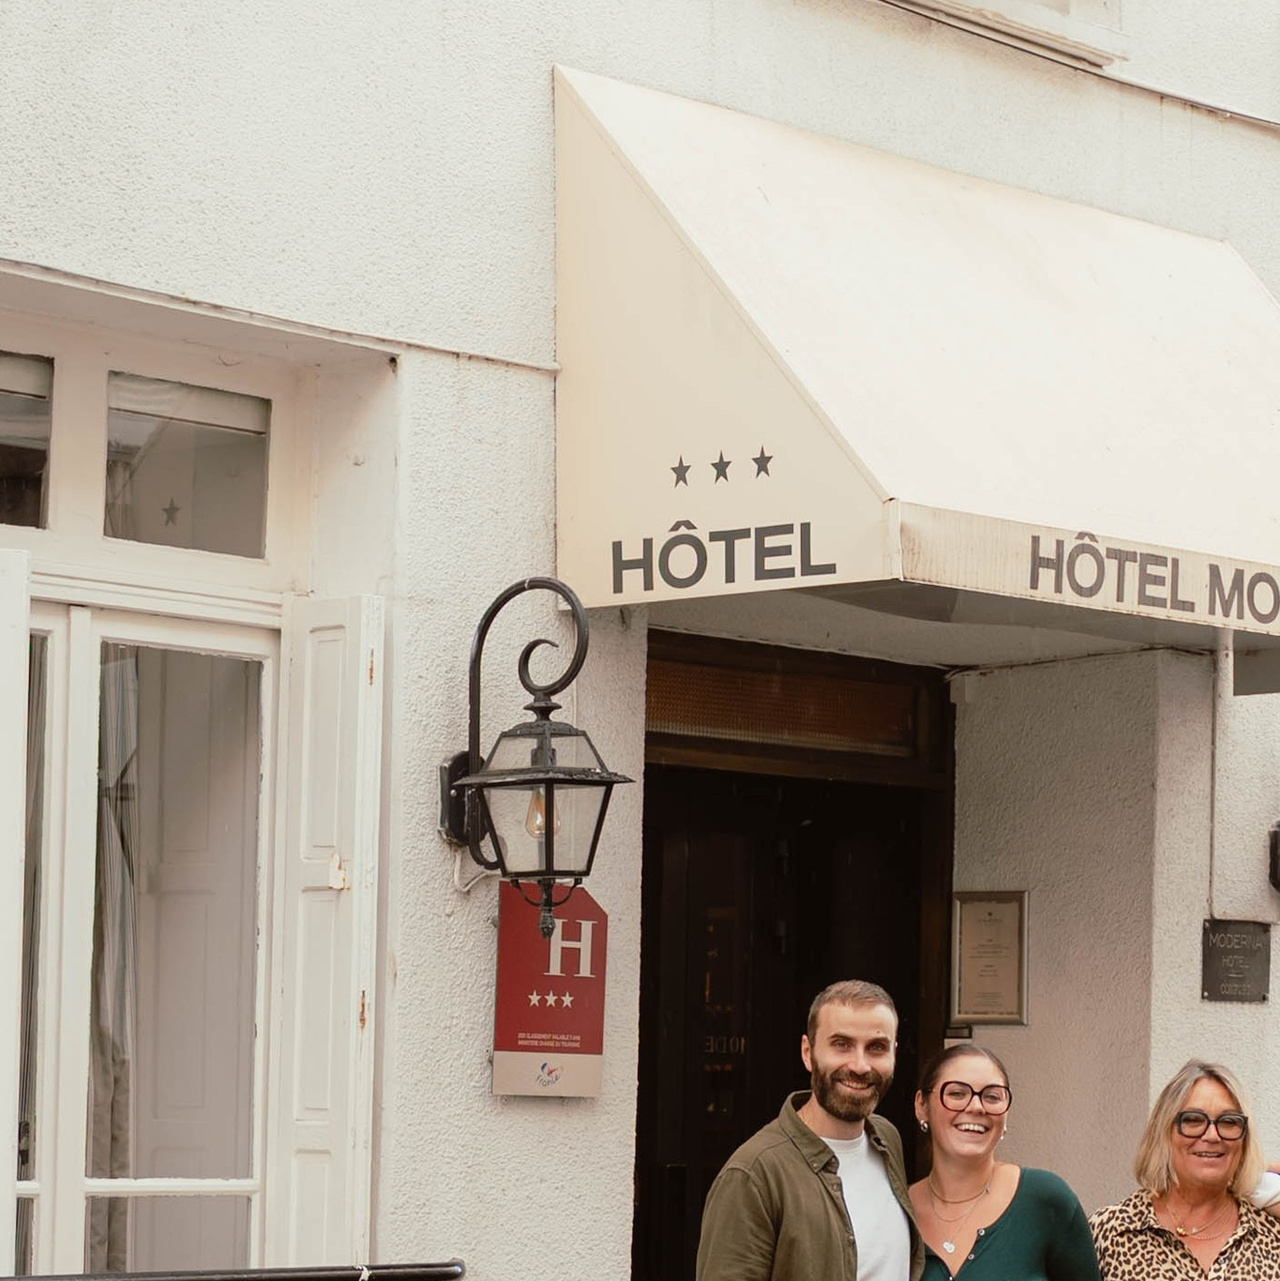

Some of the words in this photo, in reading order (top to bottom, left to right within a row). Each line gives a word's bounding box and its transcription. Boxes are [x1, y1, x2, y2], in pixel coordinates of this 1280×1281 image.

[612, 520, 836, 595] HÔTEL
[1030, 532, 1195, 619] HÔTEL
[543, 918, 598, 978] H
[1209, 933, 1263, 950] MODERNA
